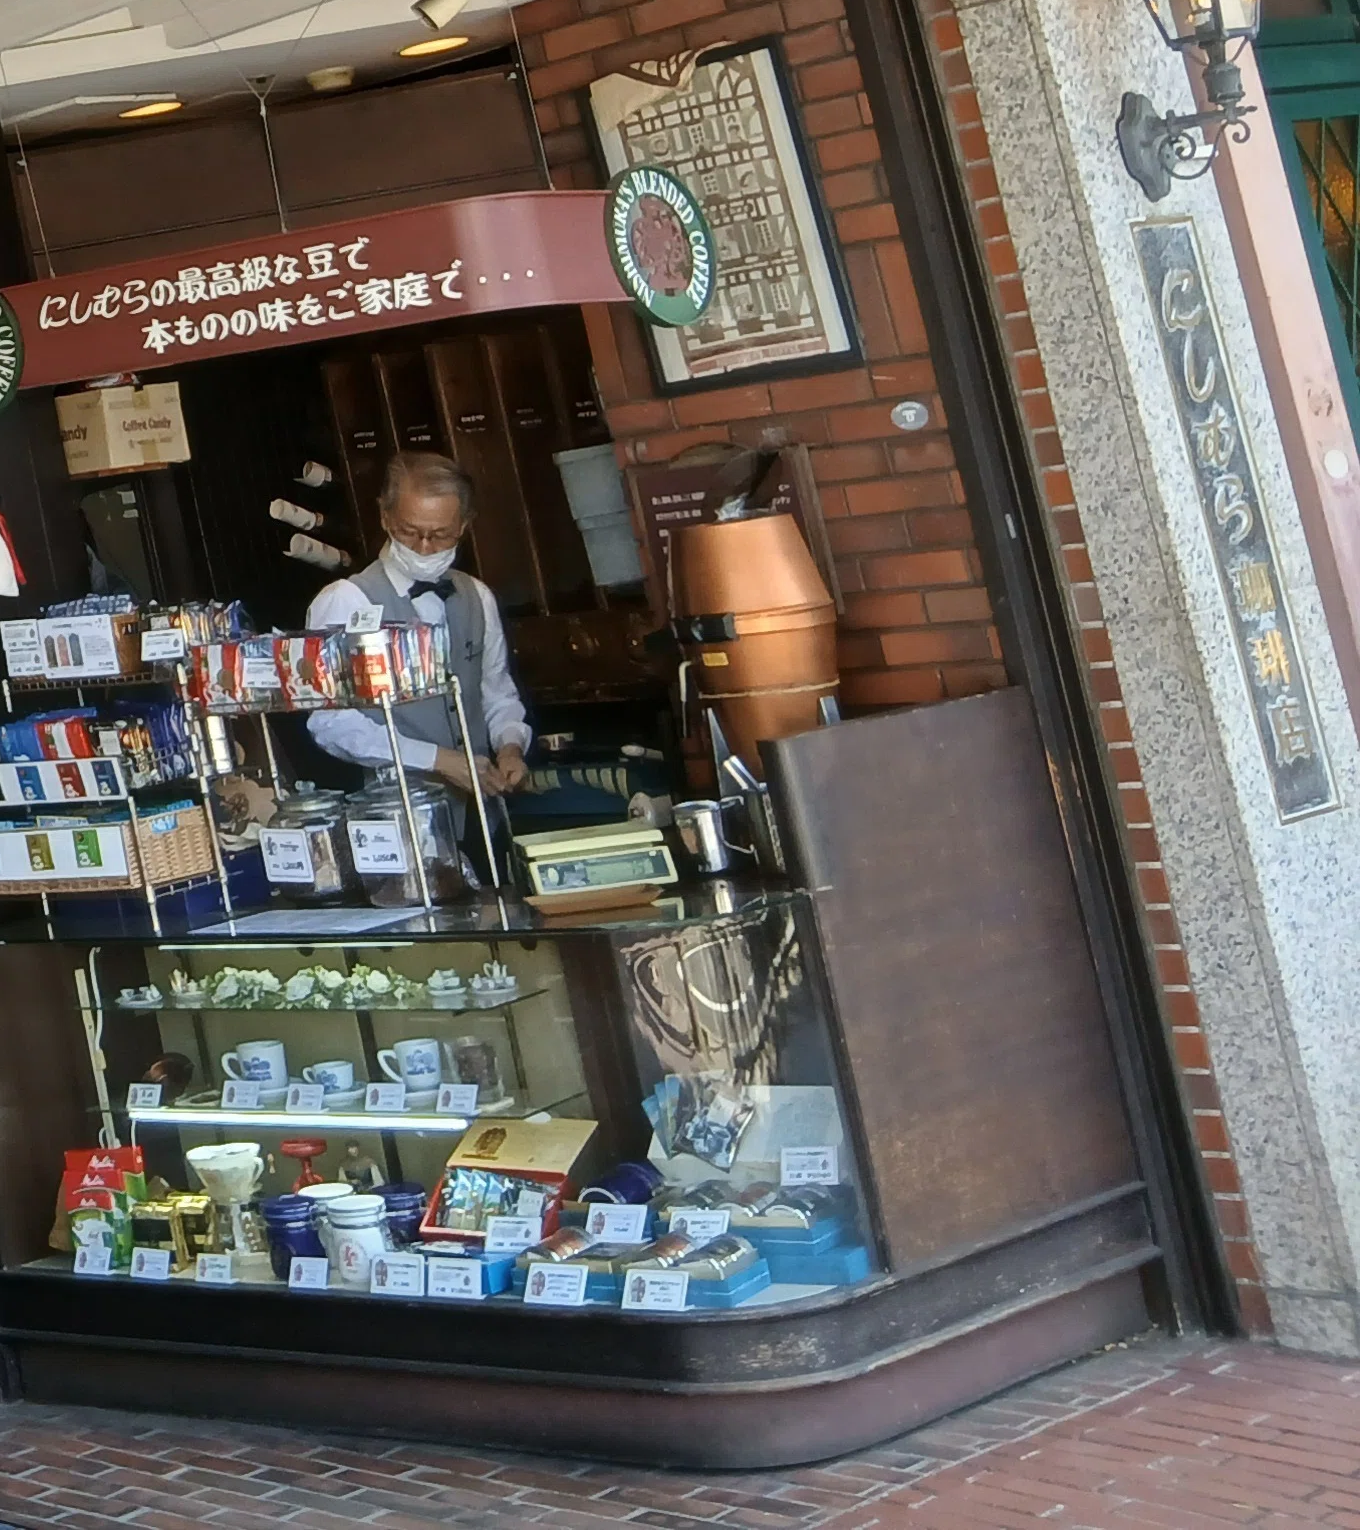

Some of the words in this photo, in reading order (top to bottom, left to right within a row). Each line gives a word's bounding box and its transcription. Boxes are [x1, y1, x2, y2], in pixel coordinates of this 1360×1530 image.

[37, 237, 372, 331] にしむらの最高級な豆で
[630, 169, 695, 225] BLENDED
[685, 230, 711, 311] COFFEE
